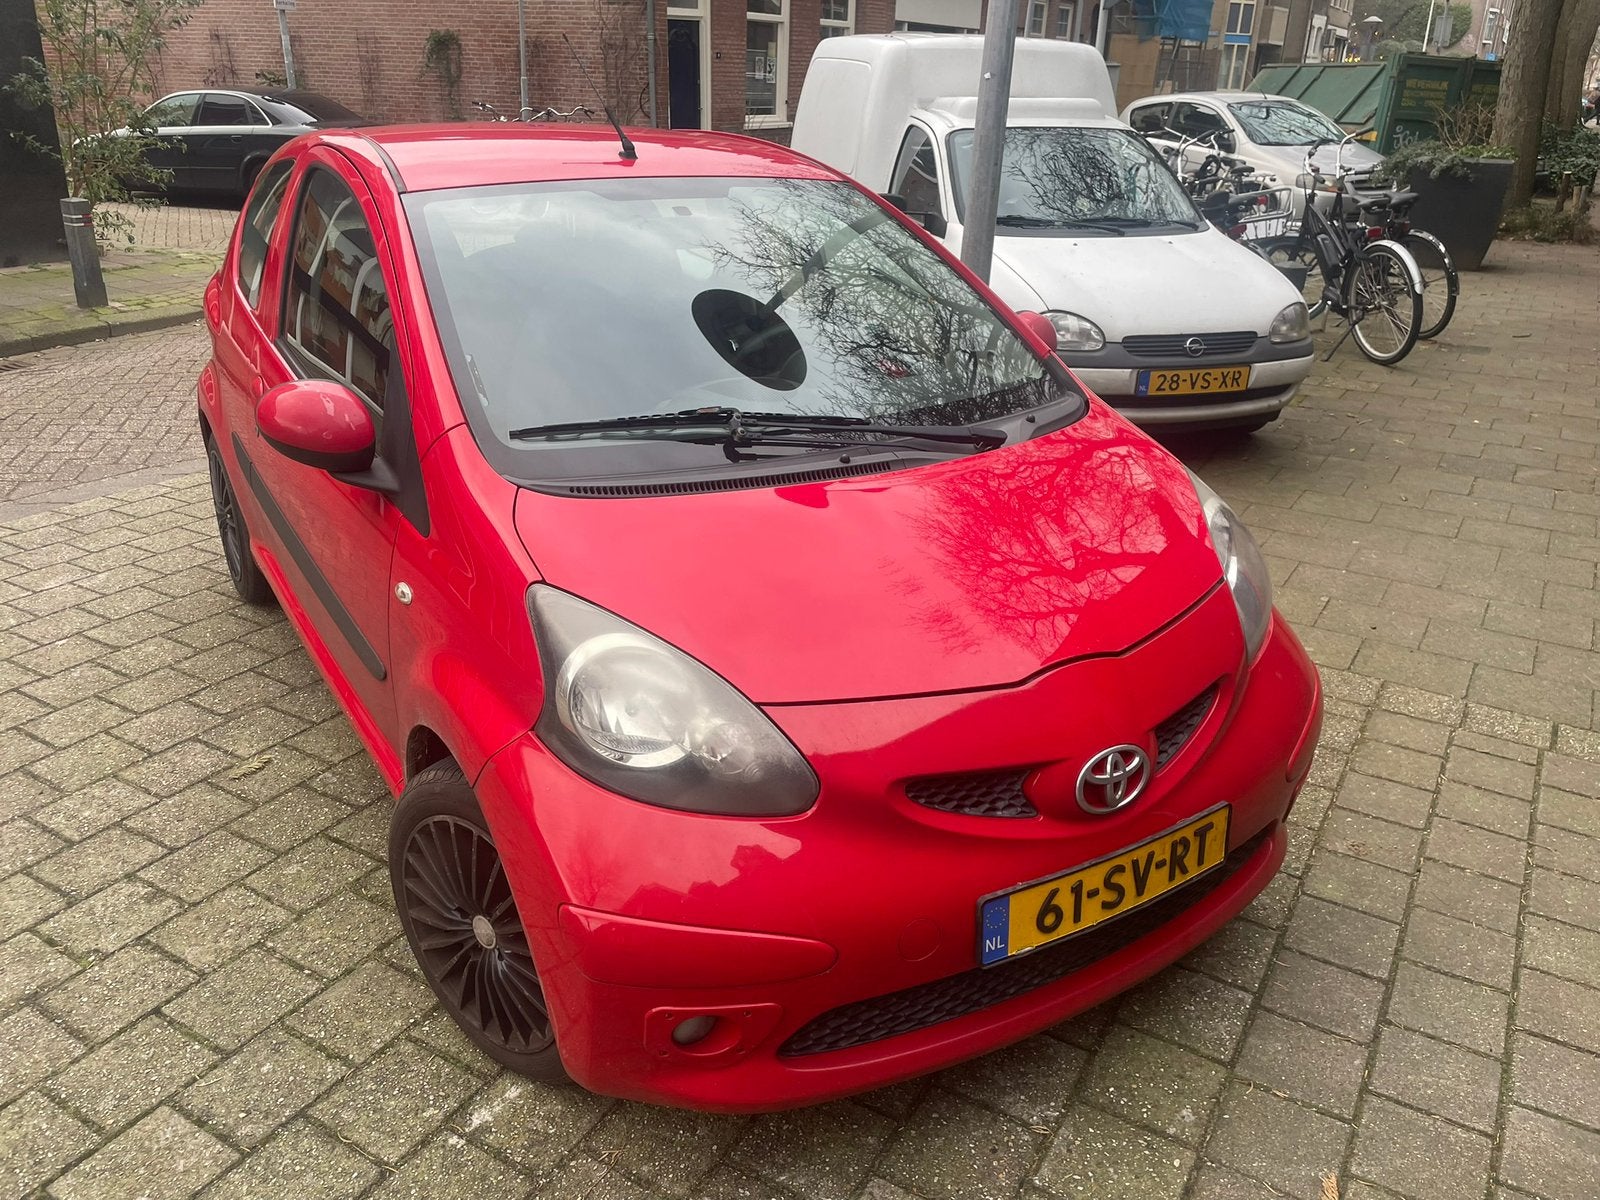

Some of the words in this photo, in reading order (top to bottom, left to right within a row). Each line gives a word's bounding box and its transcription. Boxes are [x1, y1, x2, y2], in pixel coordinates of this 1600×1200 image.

[1155, 370, 1242, 392] 28-VS-XR
[1035, 821, 1215, 934] 61-SV-RT
[985, 935, 1005, 953] NL
